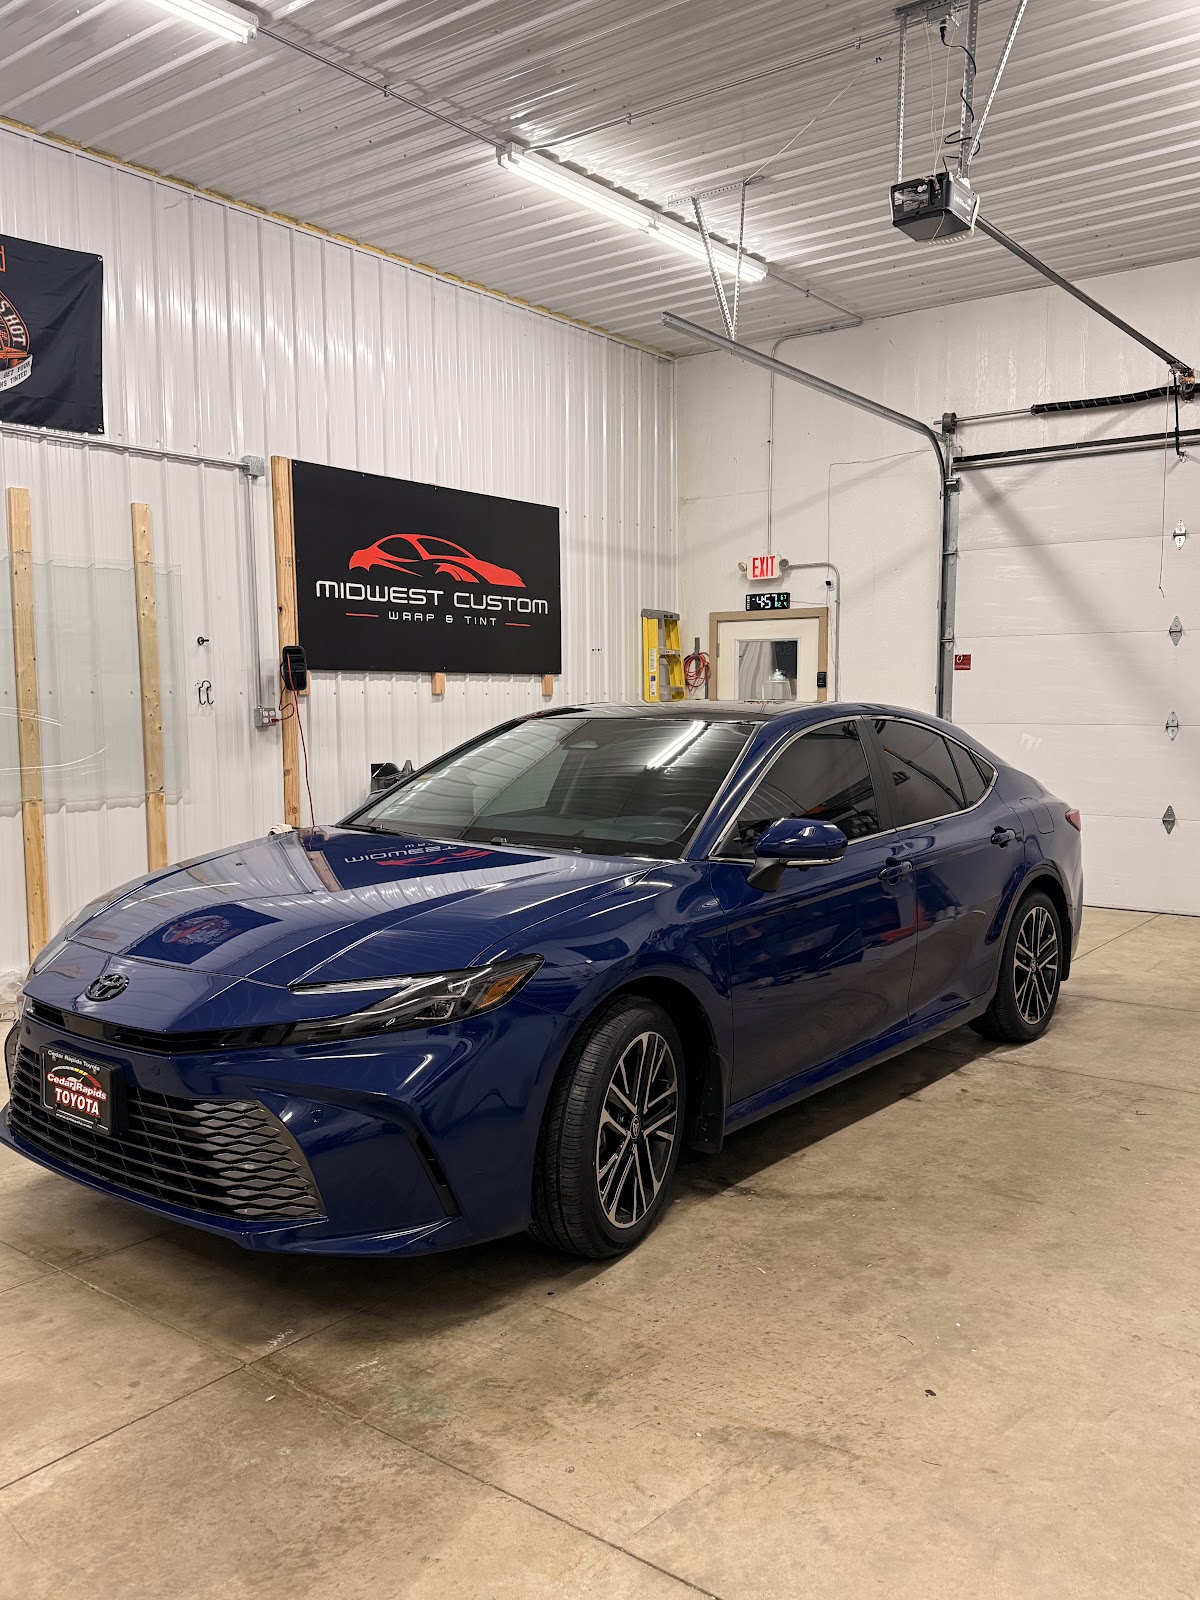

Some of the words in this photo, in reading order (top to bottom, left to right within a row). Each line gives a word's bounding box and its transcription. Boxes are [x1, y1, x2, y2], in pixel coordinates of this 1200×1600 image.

[3, 314, 27, 347] HOT
[752, 555, 776, 578] EXIT
[315, 579, 445, 606] MIDWEST
[453, 591, 549, 615] CUSTOM
[388, 610, 435, 622] WRAP
[445, 614, 454, 624] &
[464, 615, 498, 626] TINT
[47, 1049, 64, 1059] Cedar
[64, 1054, 83, 1065] Rapids
[82, 1060, 101, 1072] Toyota
[47, 1072, 75, 1089] Cedar
[75, 1082, 107, 1100] Rapids
[55, 1087, 100, 1116] TOYOTA
